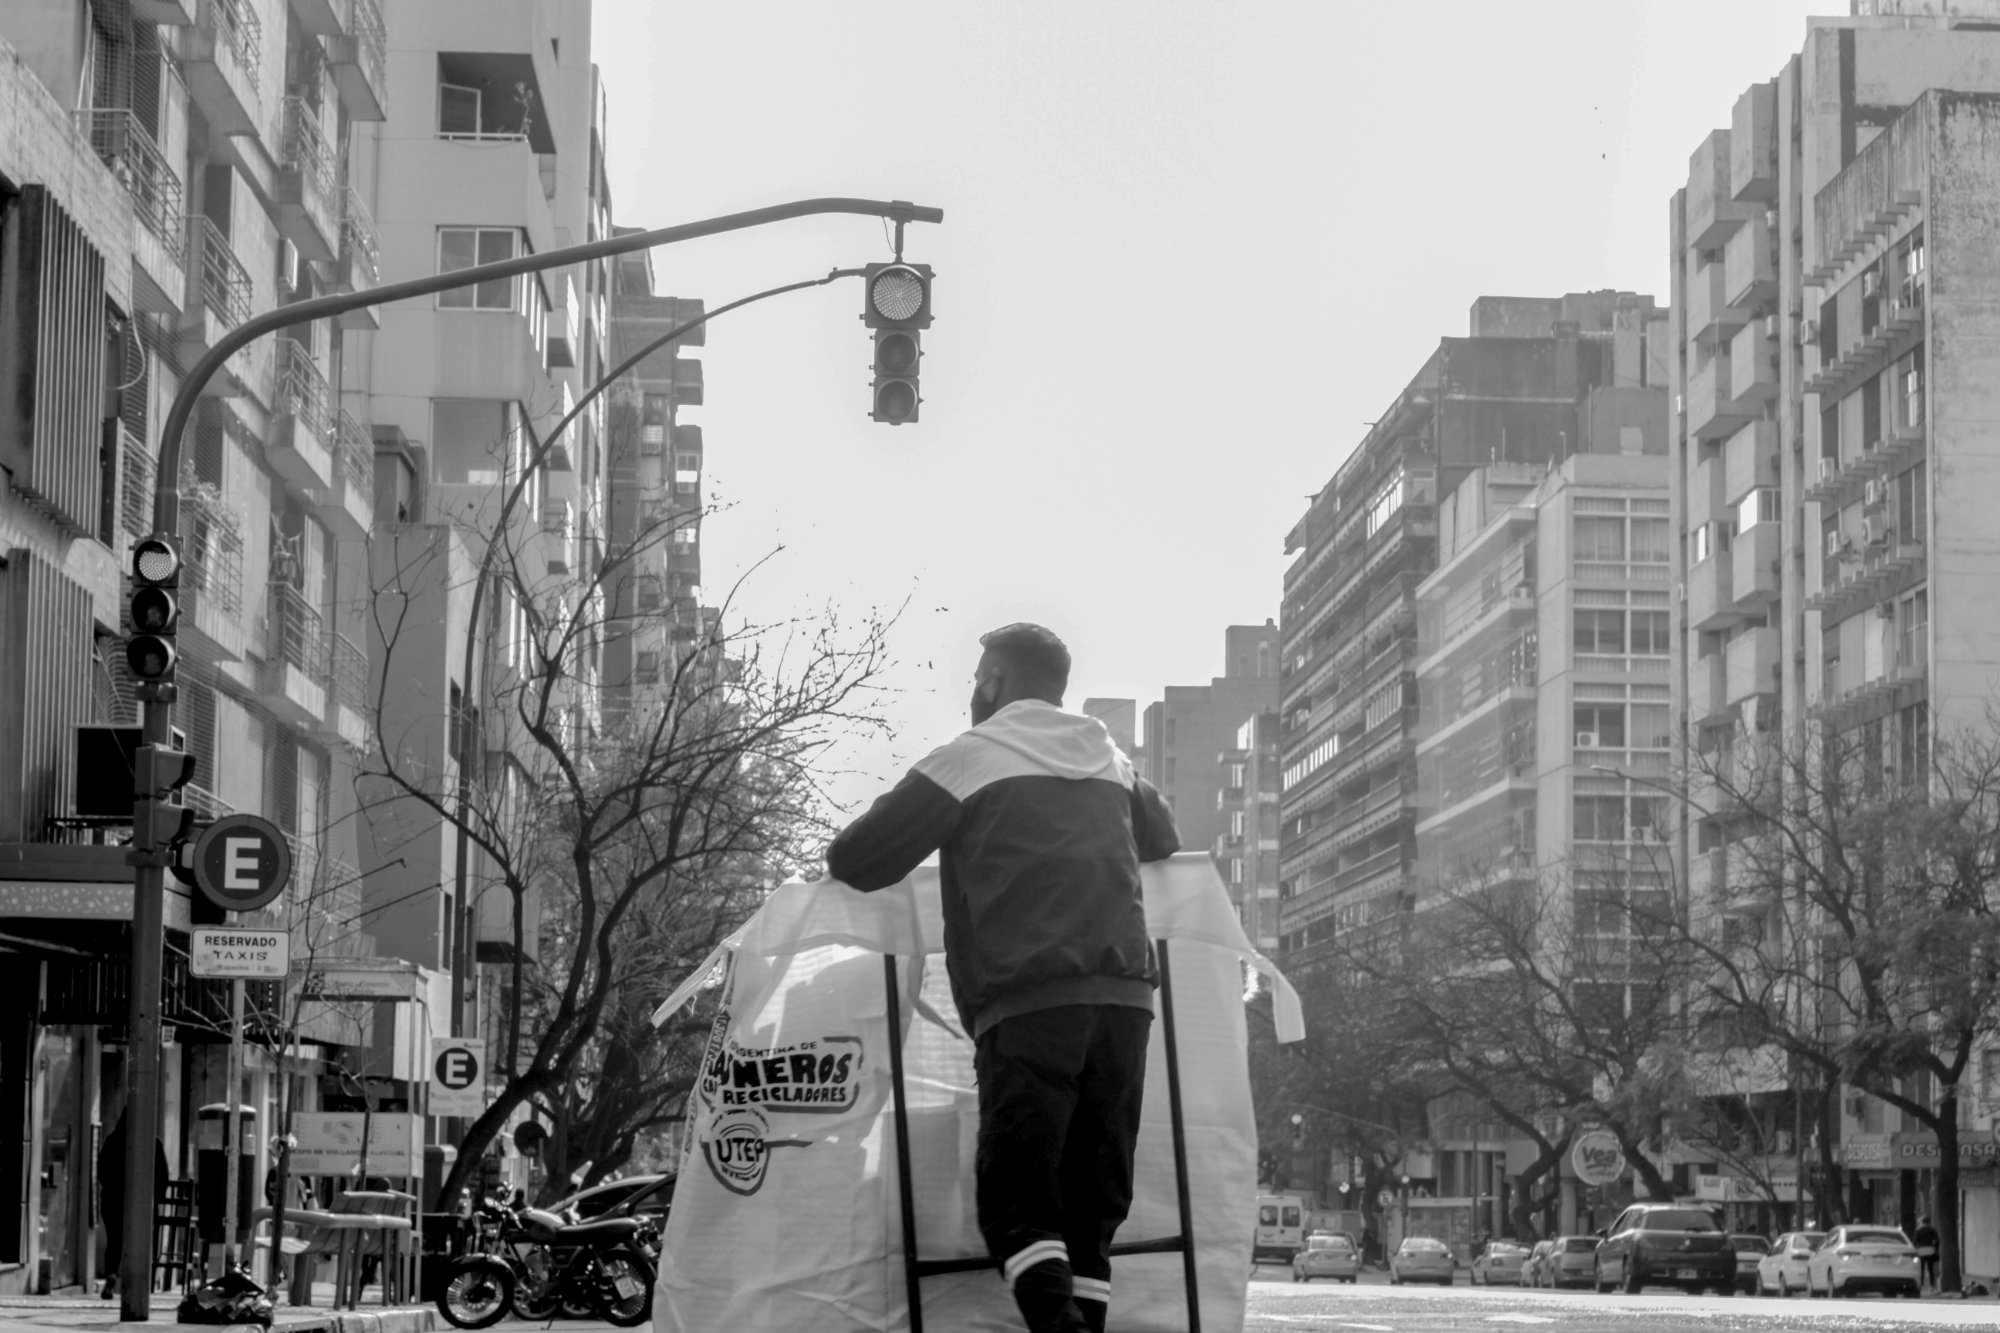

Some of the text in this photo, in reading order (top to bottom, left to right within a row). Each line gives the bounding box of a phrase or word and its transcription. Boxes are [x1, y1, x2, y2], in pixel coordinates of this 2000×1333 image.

[224, 837, 261, 889] E
[205, 936, 277, 947] RESERVADO
[213, 950, 267, 961] TAXIS
[801, 1041, 817, 1050] DE
[446, 1053, 468, 1085] E
[723, 1086, 847, 1105] RECICLADORES
[716, 1137, 764, 1163] UTEP
[1582, 1147, 1617, 1163] Vea
